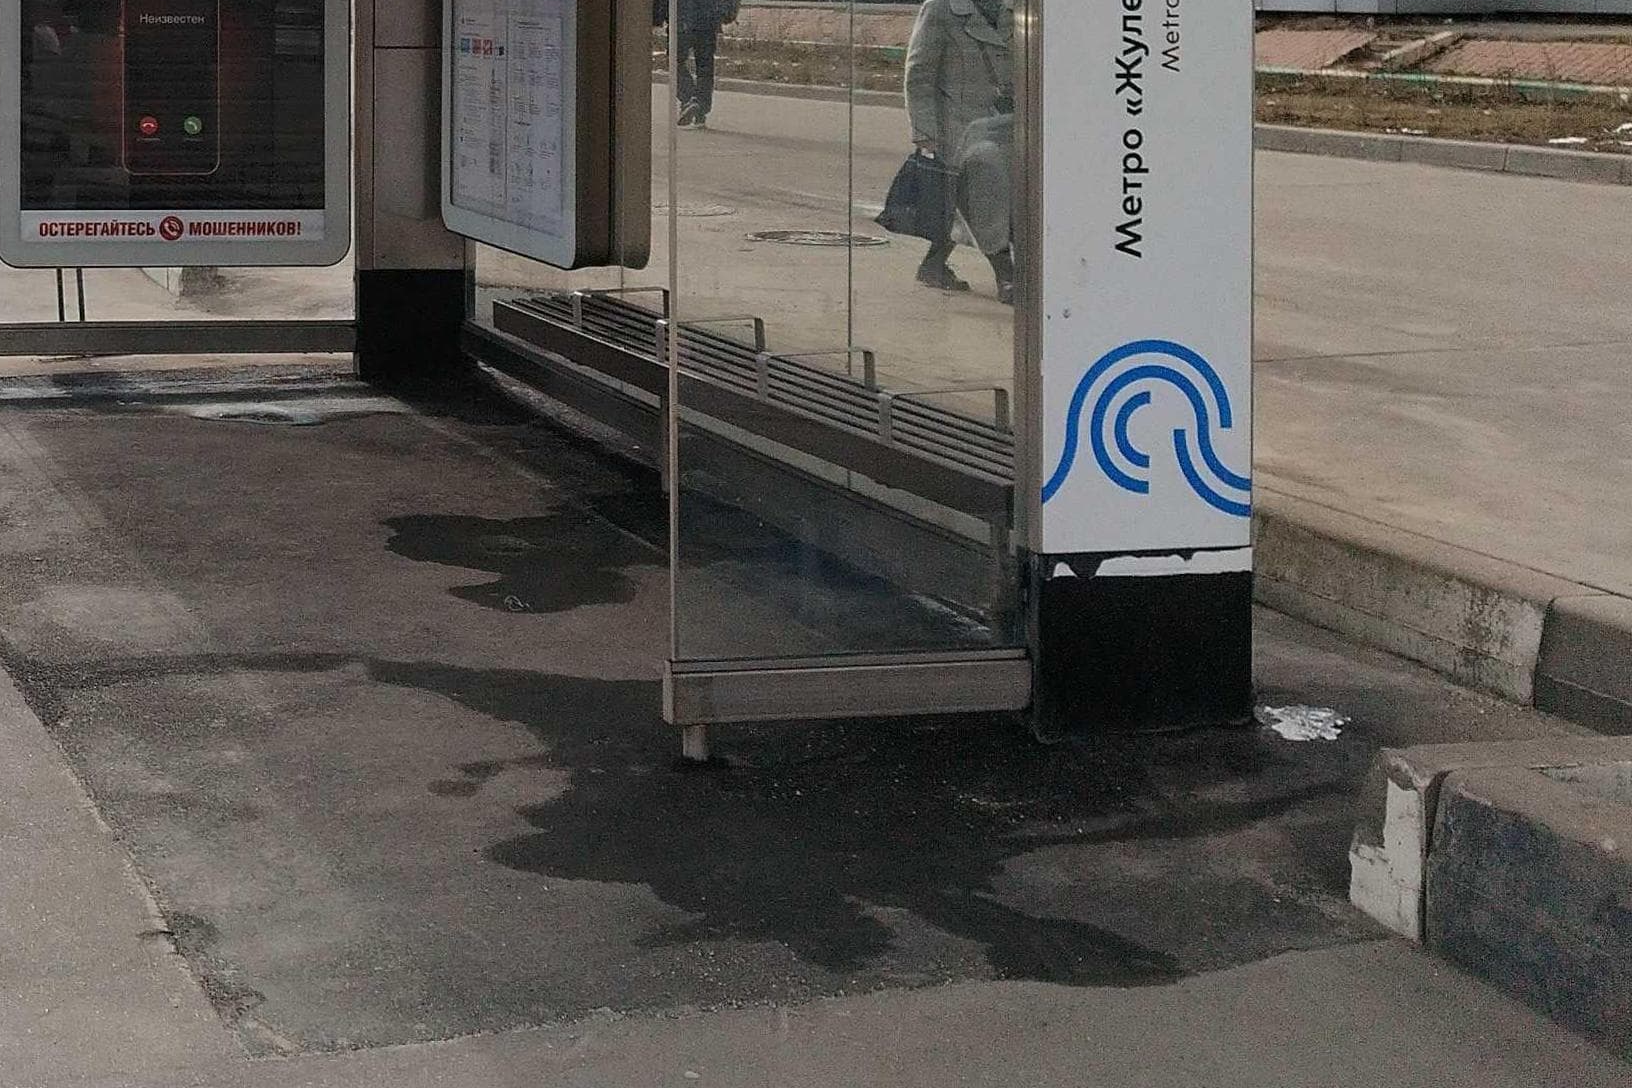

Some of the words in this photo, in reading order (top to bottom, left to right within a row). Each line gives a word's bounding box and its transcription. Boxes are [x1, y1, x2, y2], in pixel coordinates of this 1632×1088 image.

[139, 13, 205, 25] Неизвестен
[1114, 128, 1149, 258] Метро
[39, 220, 155, 237] ОСТЕРЕГАЙТЕСЬ
[189, 221, 301, 236] МОШЕННИКОВ!
